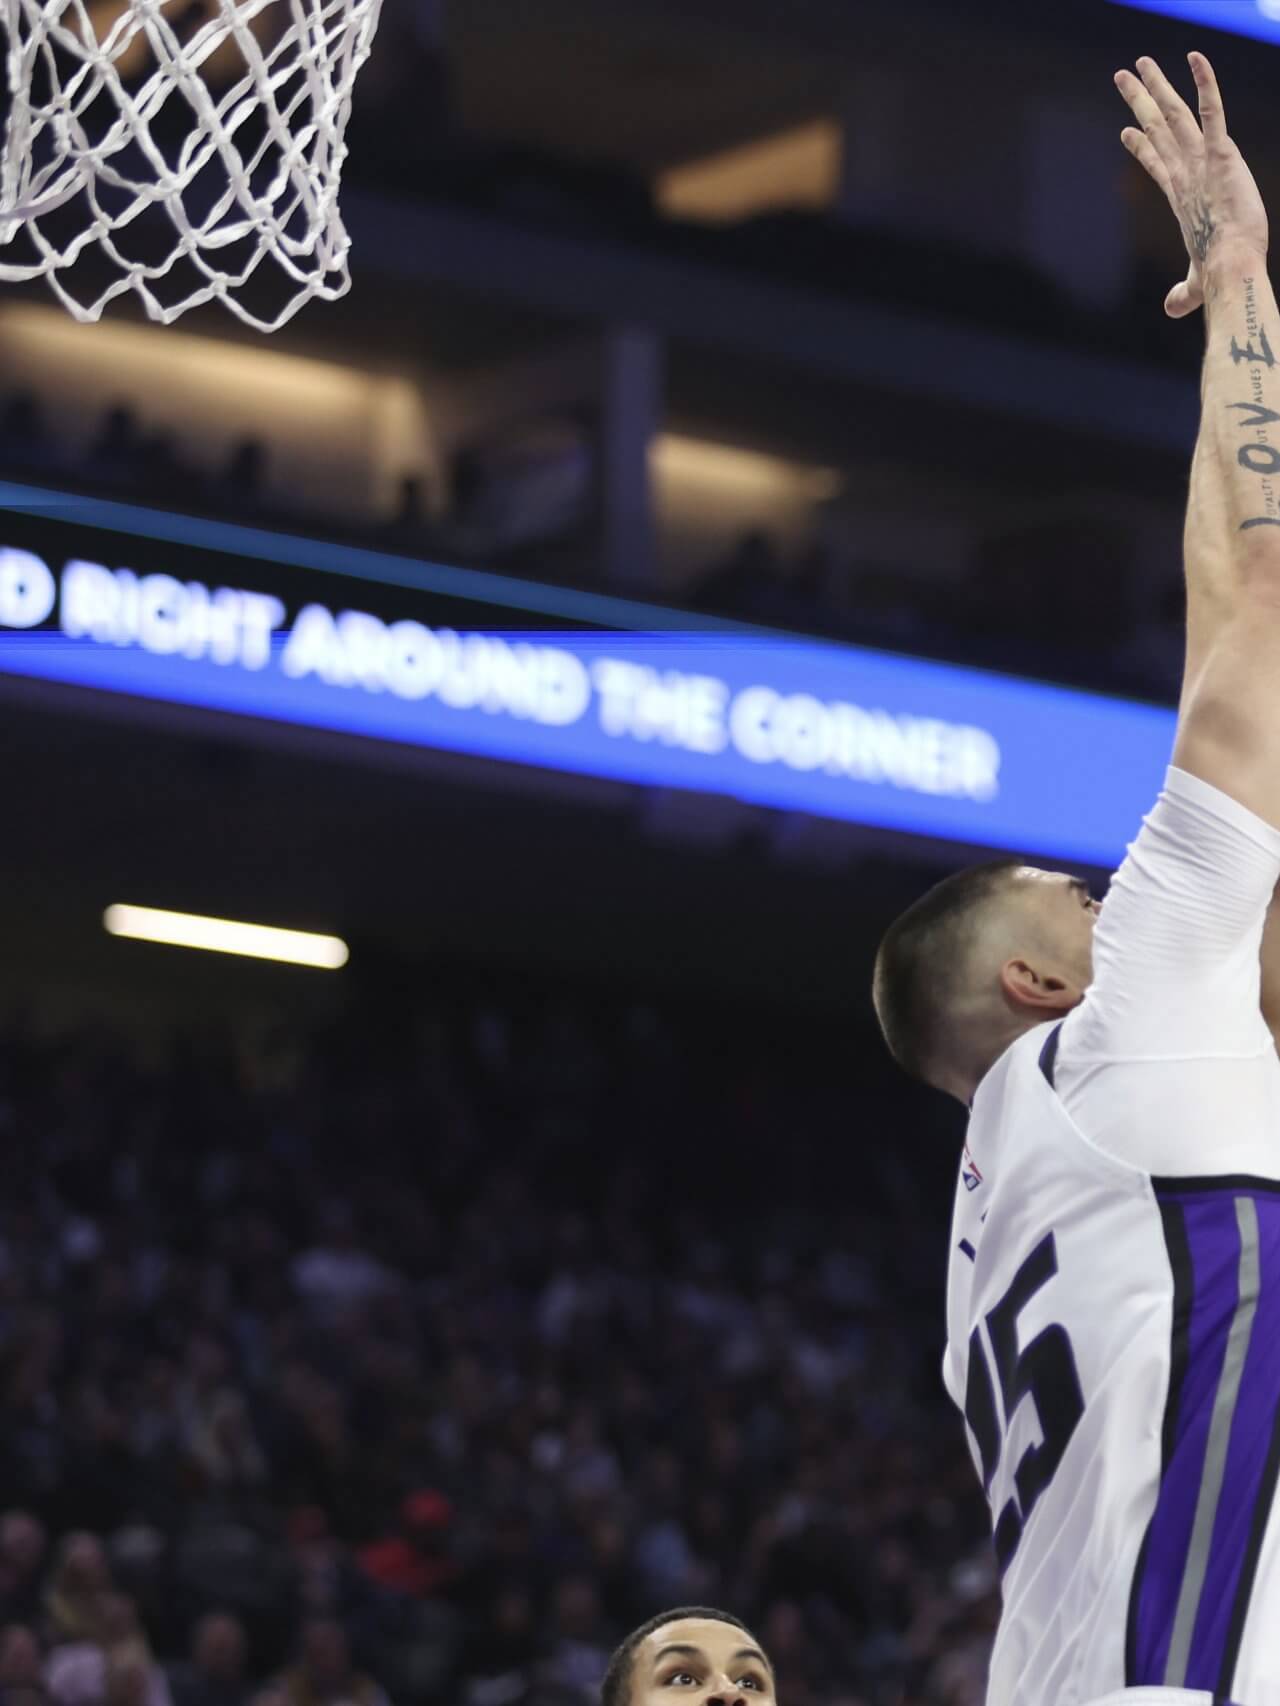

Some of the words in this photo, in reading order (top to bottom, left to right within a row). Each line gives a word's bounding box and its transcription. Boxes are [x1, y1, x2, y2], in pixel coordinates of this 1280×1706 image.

[60, 558, 287, 672] RIGHT
[280, 602, 591, 727] AROUND
[589, 656, 730, 755] THE
[729, 684, 1000, 803] CORNER
